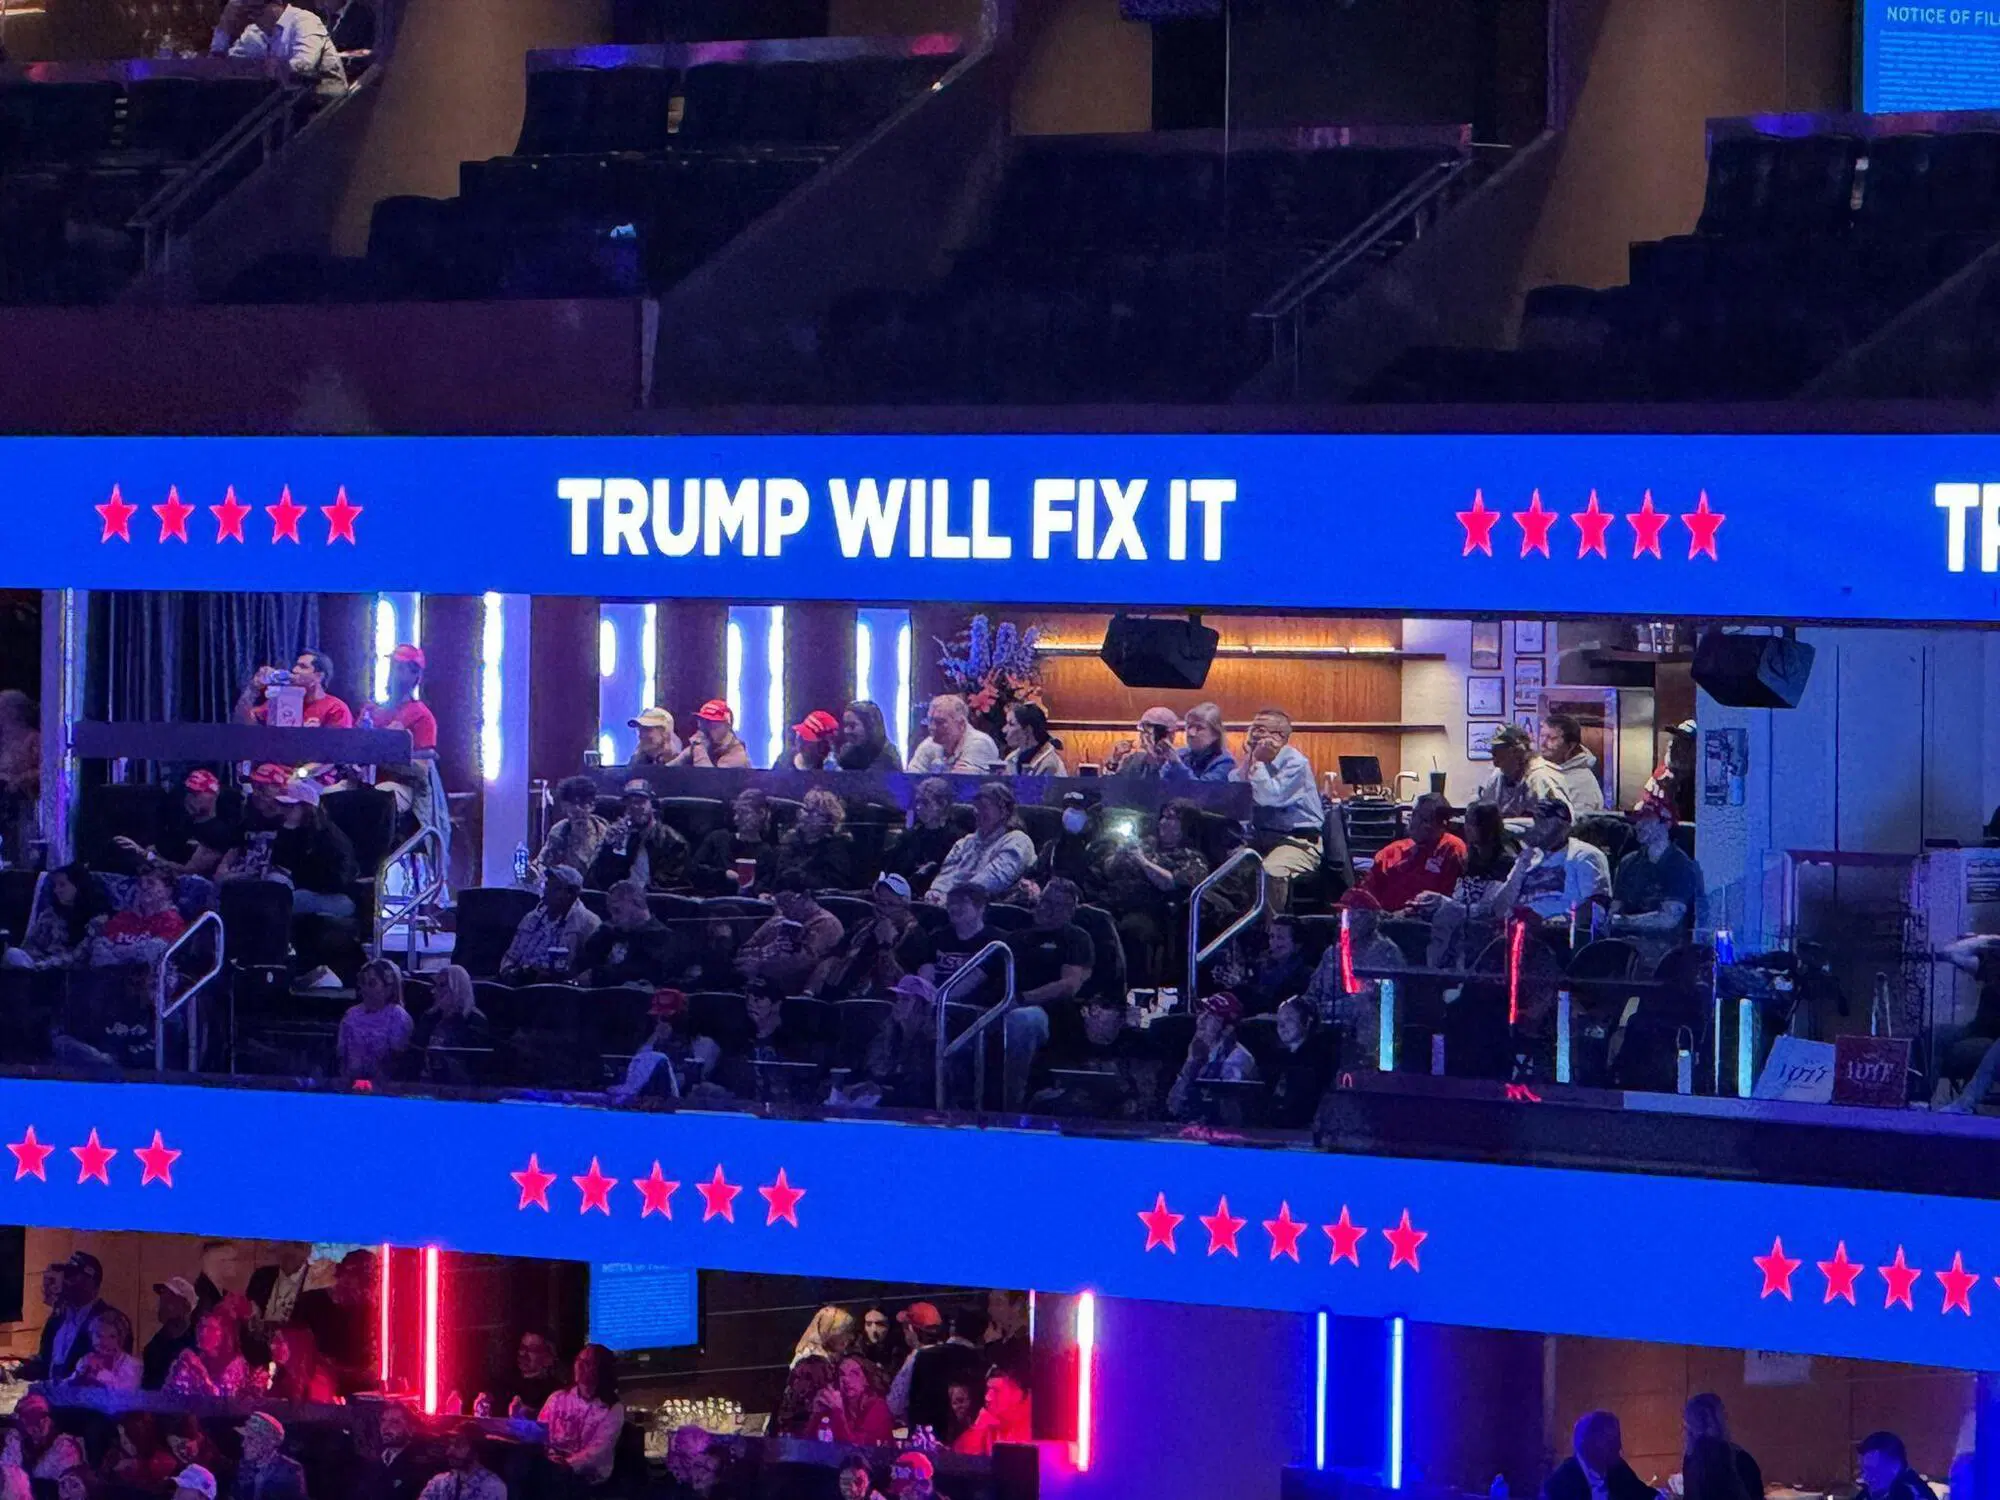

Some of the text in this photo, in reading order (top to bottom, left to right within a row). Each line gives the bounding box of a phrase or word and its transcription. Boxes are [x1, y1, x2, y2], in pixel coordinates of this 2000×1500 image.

[1887, 7, 2000, 26] NOTICE OF FIL
[558, 477, 1237, 562] TRUMP WILL FIX IT
